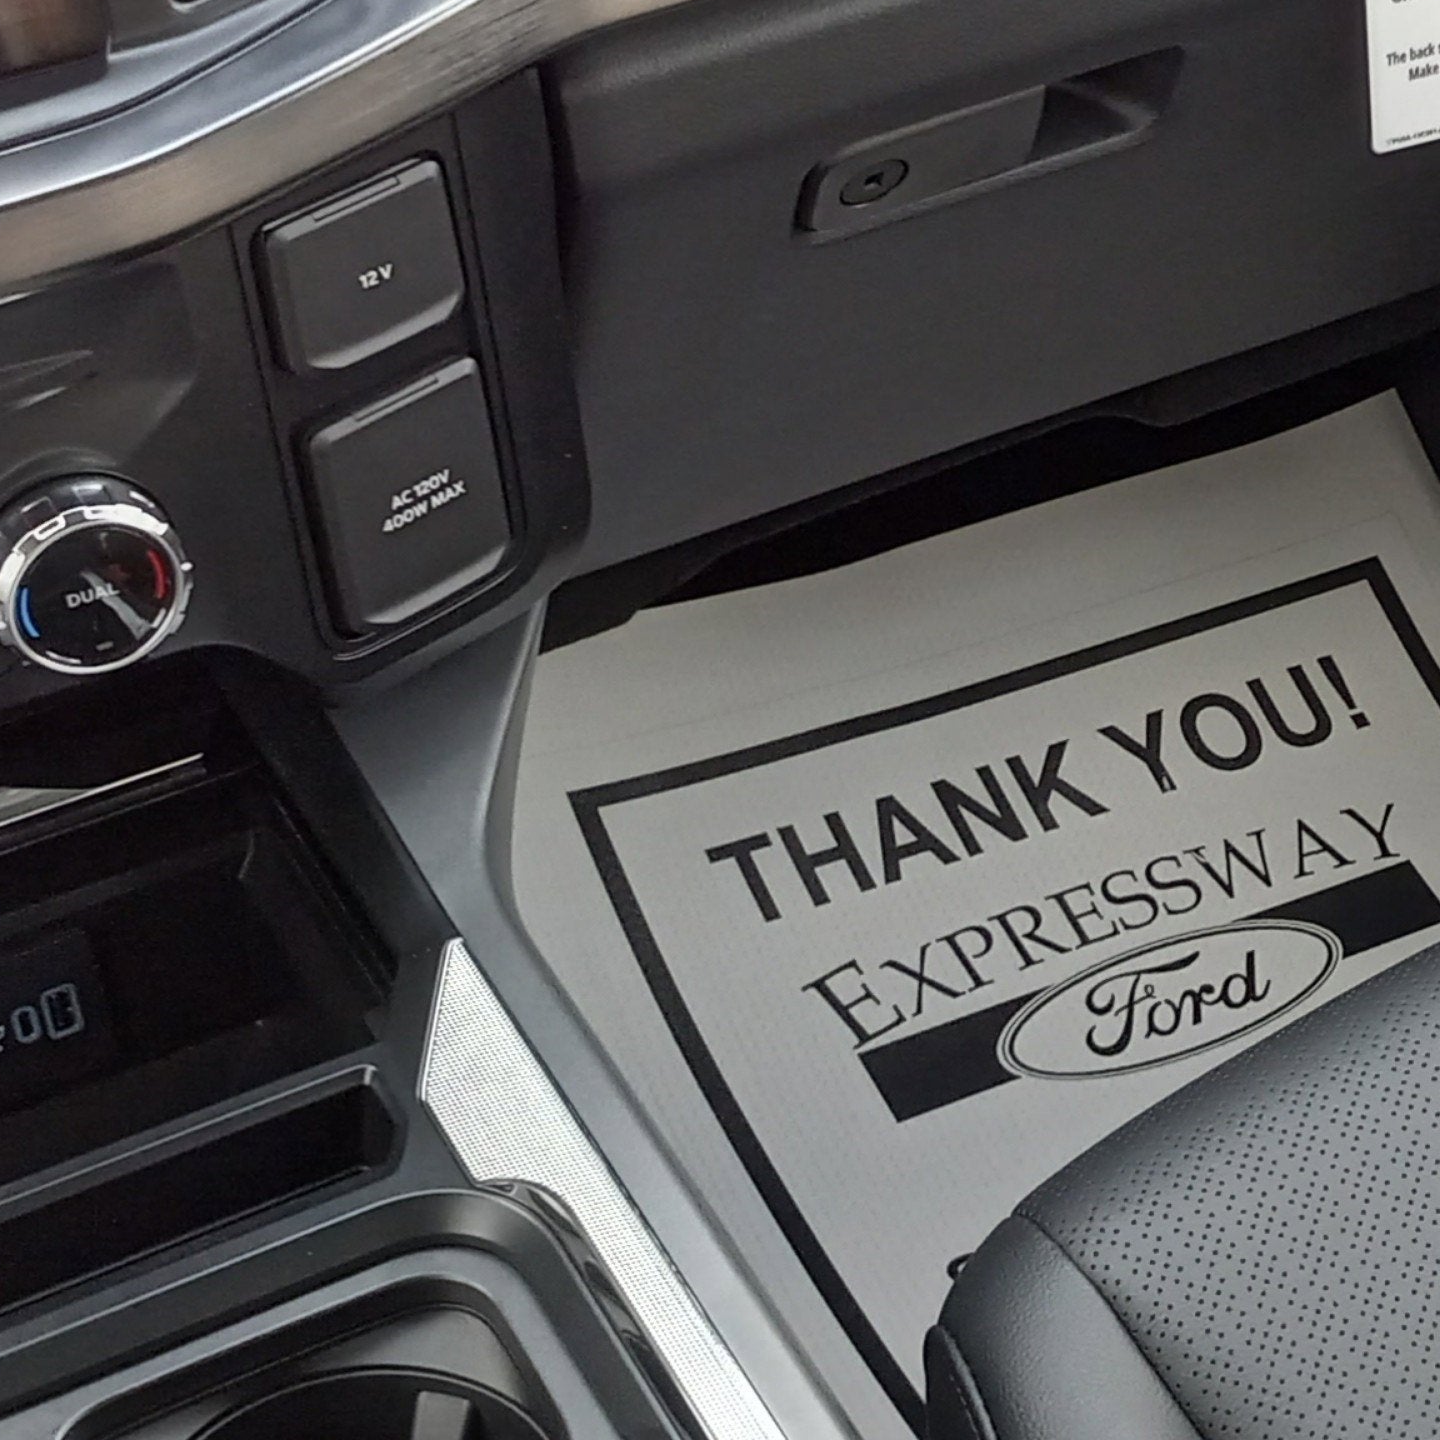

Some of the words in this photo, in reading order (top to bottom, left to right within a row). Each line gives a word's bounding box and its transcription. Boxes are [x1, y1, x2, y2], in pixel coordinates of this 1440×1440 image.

[1386, 51, 1407, 67] The
[1409, 42, 1436, 61] back
[1408, 63, 1440, 82] Make
[382, 501, 429, 533] 400W
[430, 480, 467, 511] MAX
[390, 490, 413, 511] AC
[414, 468, 451, 497] 120V
[65, 582, 120, 610] DUAL
[706, 738, 1109, 924] THANK
[1097, 654, 1372, 794] YOU!
[799, 802, 1404, 1050] EXPRESSWAY
[1080, 946, 1272, 1058] Ford
